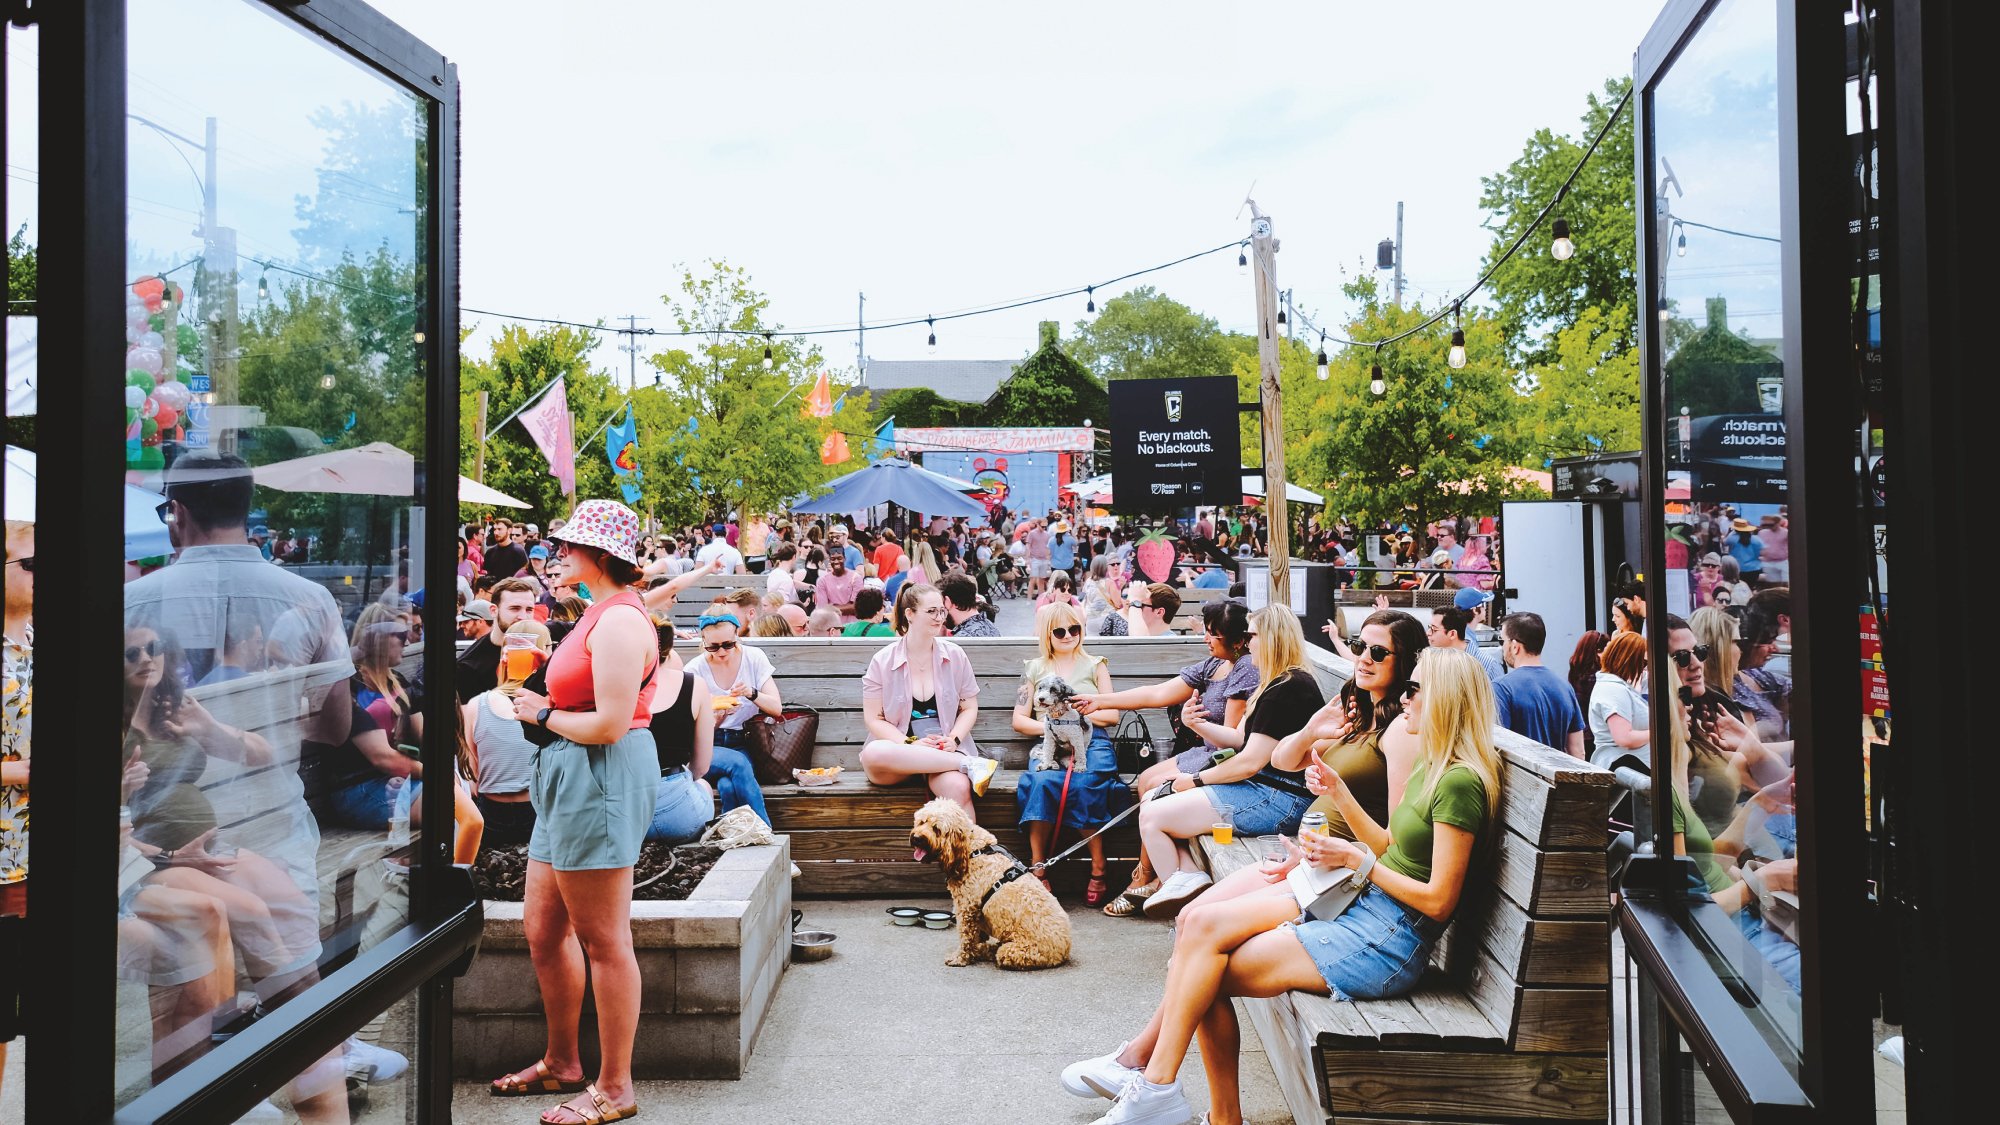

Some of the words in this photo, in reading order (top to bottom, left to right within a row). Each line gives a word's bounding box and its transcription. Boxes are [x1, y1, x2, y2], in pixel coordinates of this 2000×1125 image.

[927, 432, 999, 448] STRAWBERRY
[1139, 431, 1171, 443] Every
[1173, 429, 1211, 440] match.
[1137, 444, 1154, 455] No
[1156, 442, 1214, 454] blackouts.
